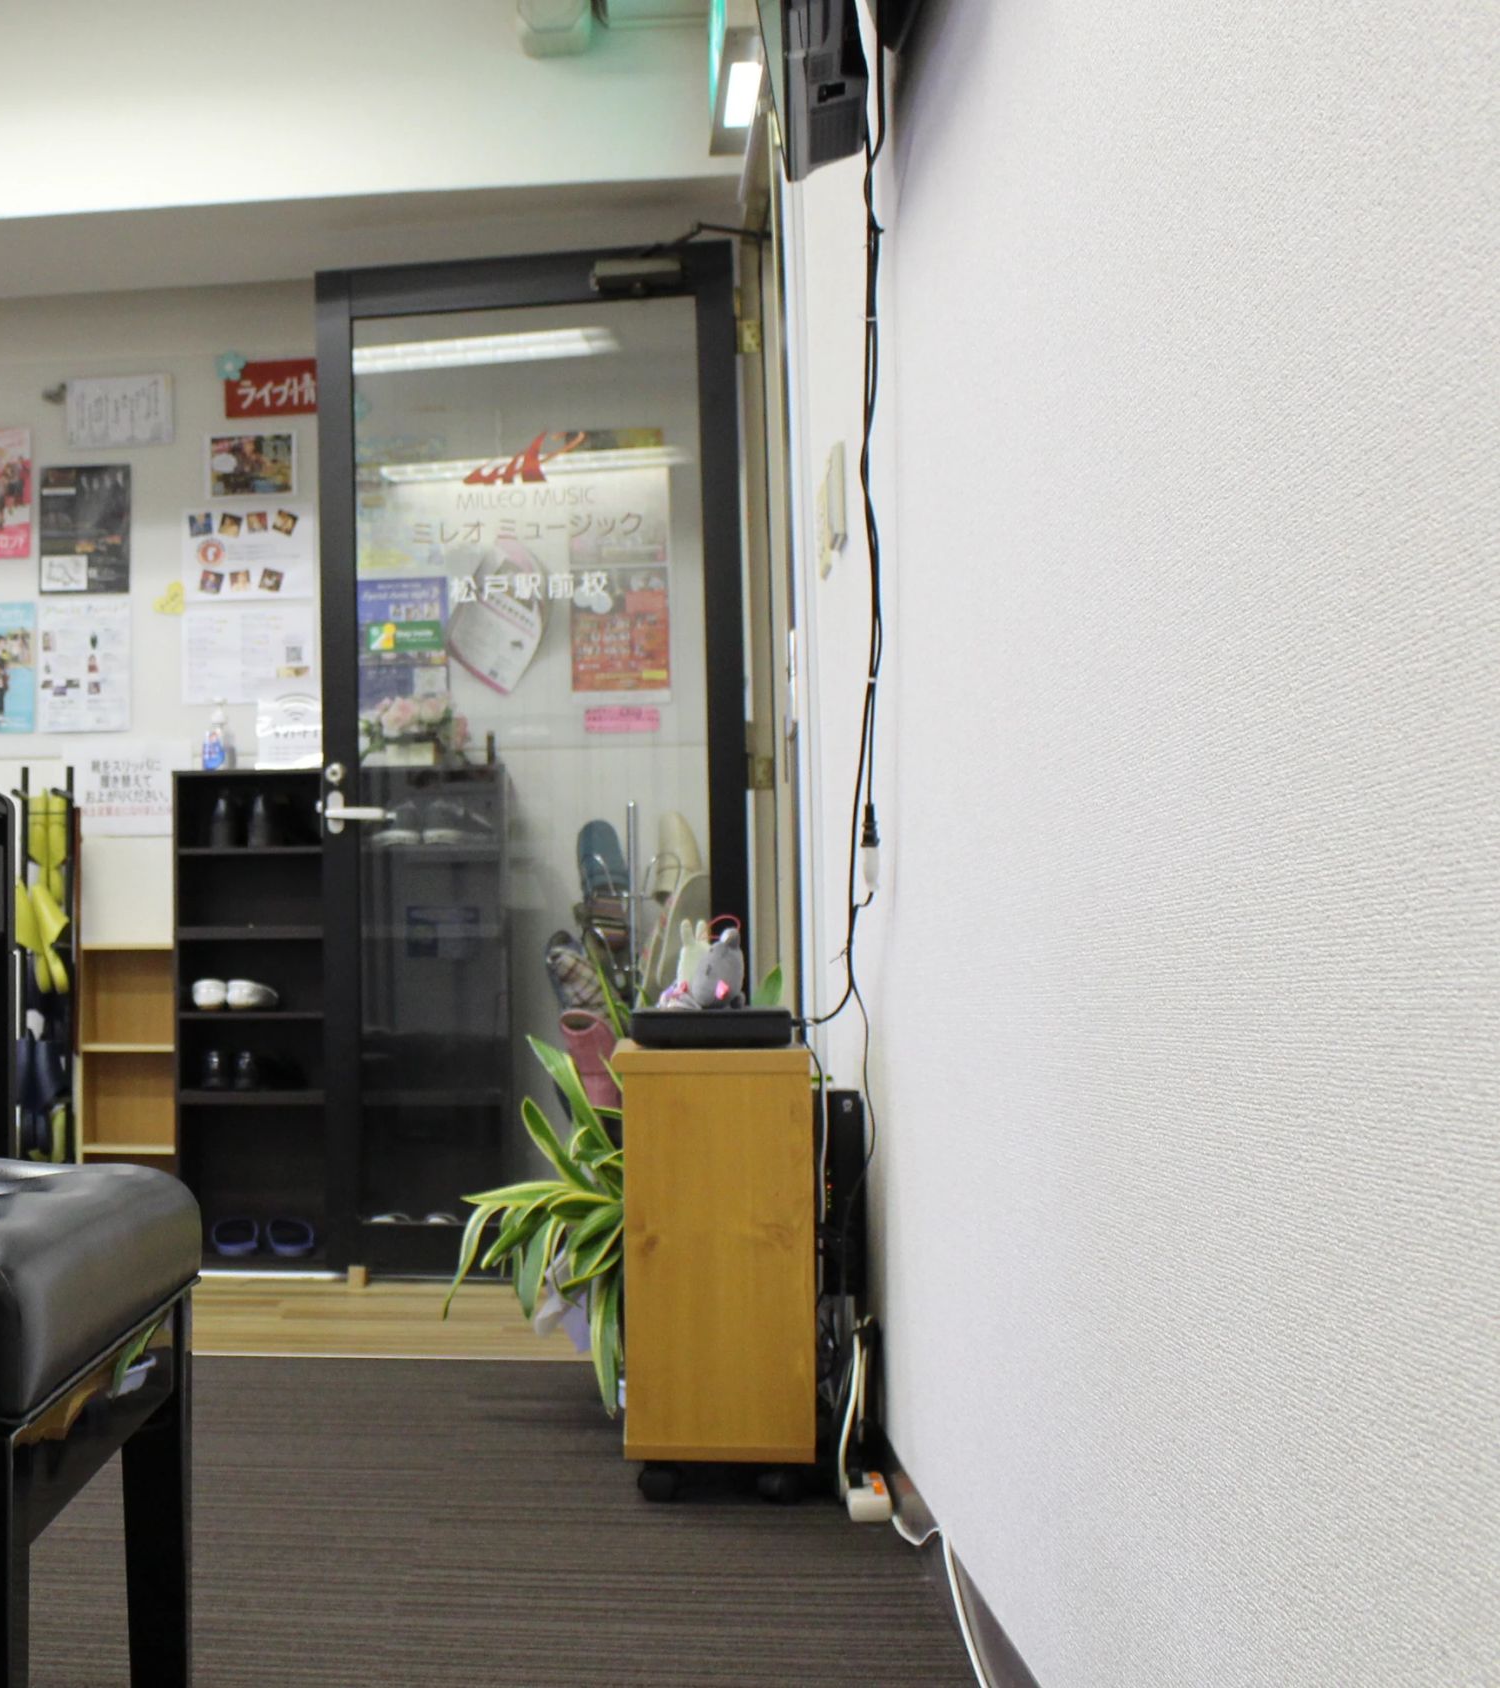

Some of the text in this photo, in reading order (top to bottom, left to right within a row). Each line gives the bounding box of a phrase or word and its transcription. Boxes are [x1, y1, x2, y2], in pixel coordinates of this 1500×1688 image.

[455, 487, 597, 511] MILLEO MUSIC
[412, 512, 643, 545] ミレオ ミュージック
[450, 570, 611, 603] 松戸駅前校
